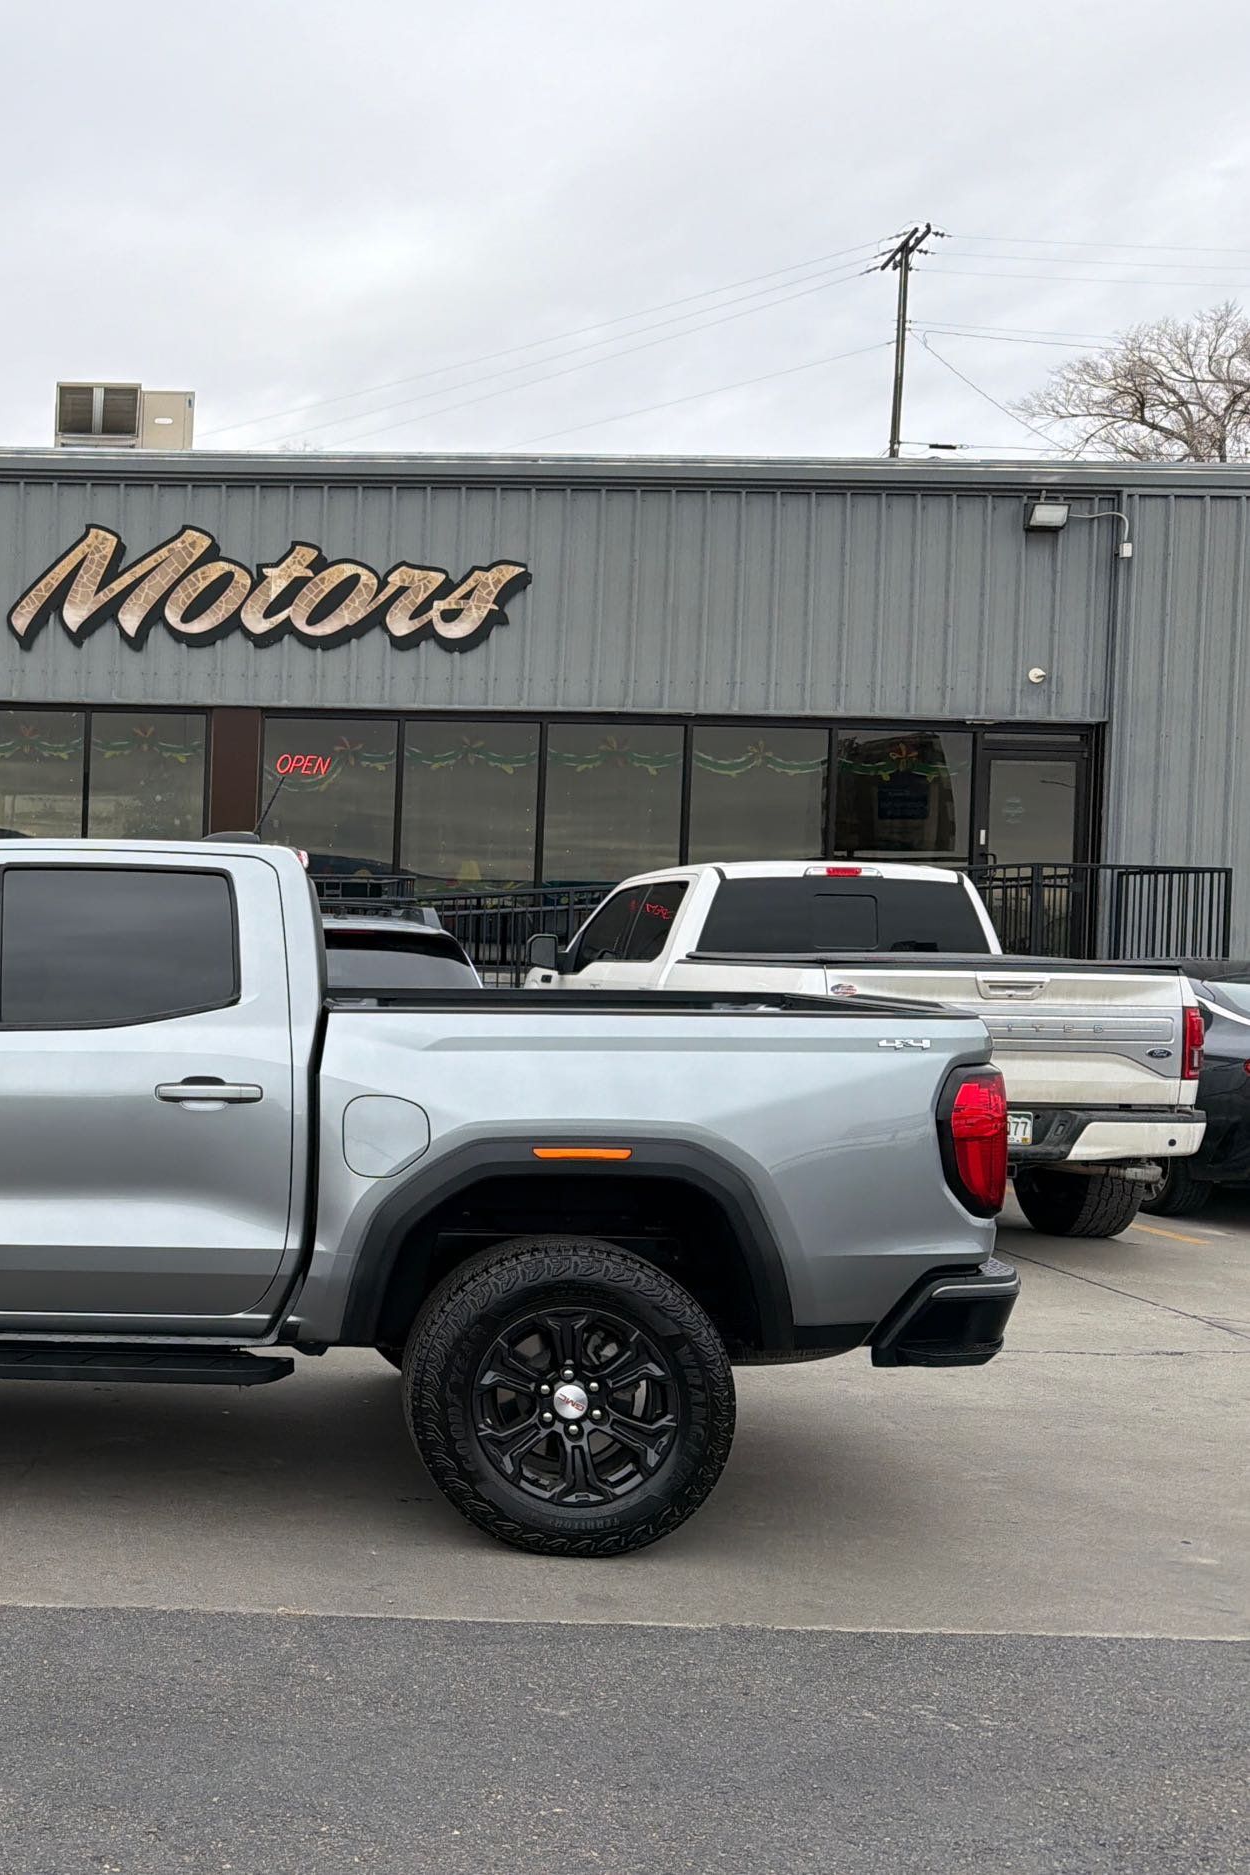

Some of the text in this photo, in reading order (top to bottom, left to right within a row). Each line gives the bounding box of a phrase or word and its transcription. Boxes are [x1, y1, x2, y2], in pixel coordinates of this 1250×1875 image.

[8, 525, 530, 650] Motors
[276, 754, 331, 775] OPEN
[557, 1393, 584, 1411] GMC
